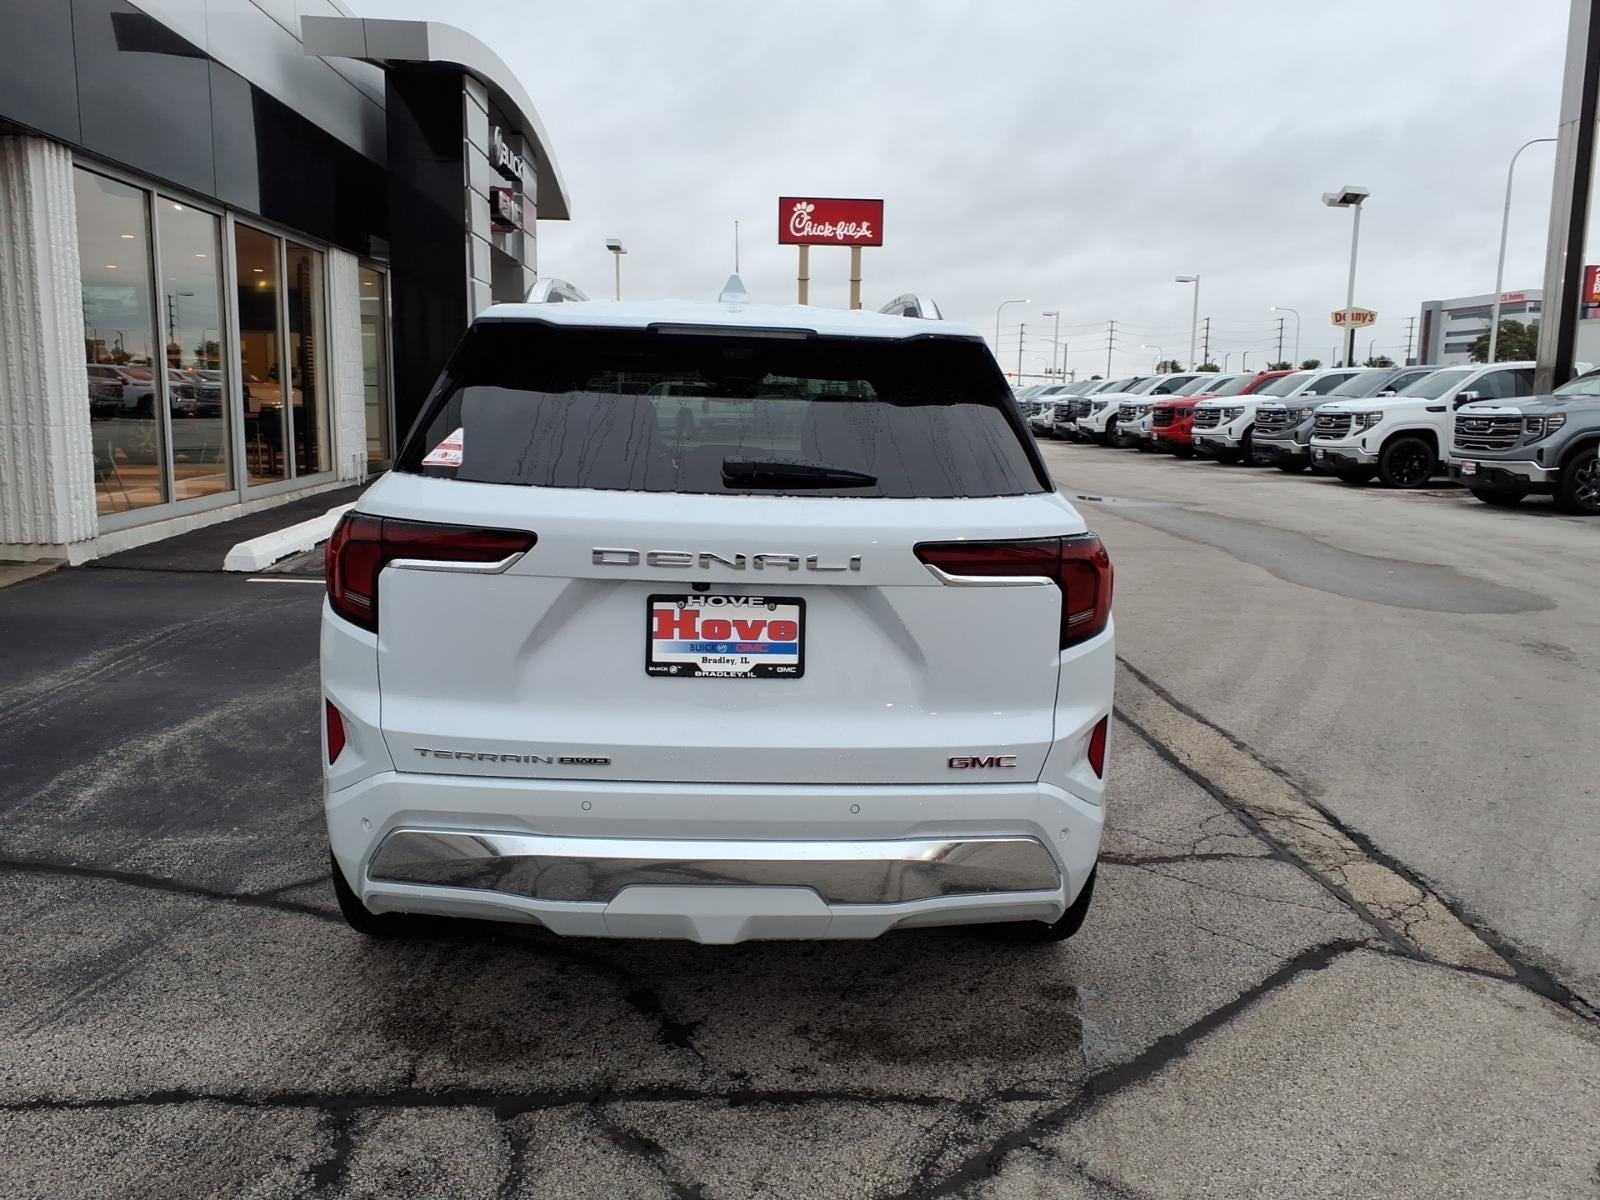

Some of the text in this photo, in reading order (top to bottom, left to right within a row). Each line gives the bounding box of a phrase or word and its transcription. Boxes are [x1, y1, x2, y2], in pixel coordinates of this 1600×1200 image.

[790, 201, 873, 240] Chick-fil-A
[592, 546, 862, 572] DENALI
[686, 595, 765, 608] HOVE
[653, 608, 798, 641] Hove
[689, 643, 769, 652] BUICK GMC
[701, 656, 750, 665] Bradley, IL
[413, 747, 610, 765] TERRAIN AWD
[948, 754, 1017, 769] GMC
